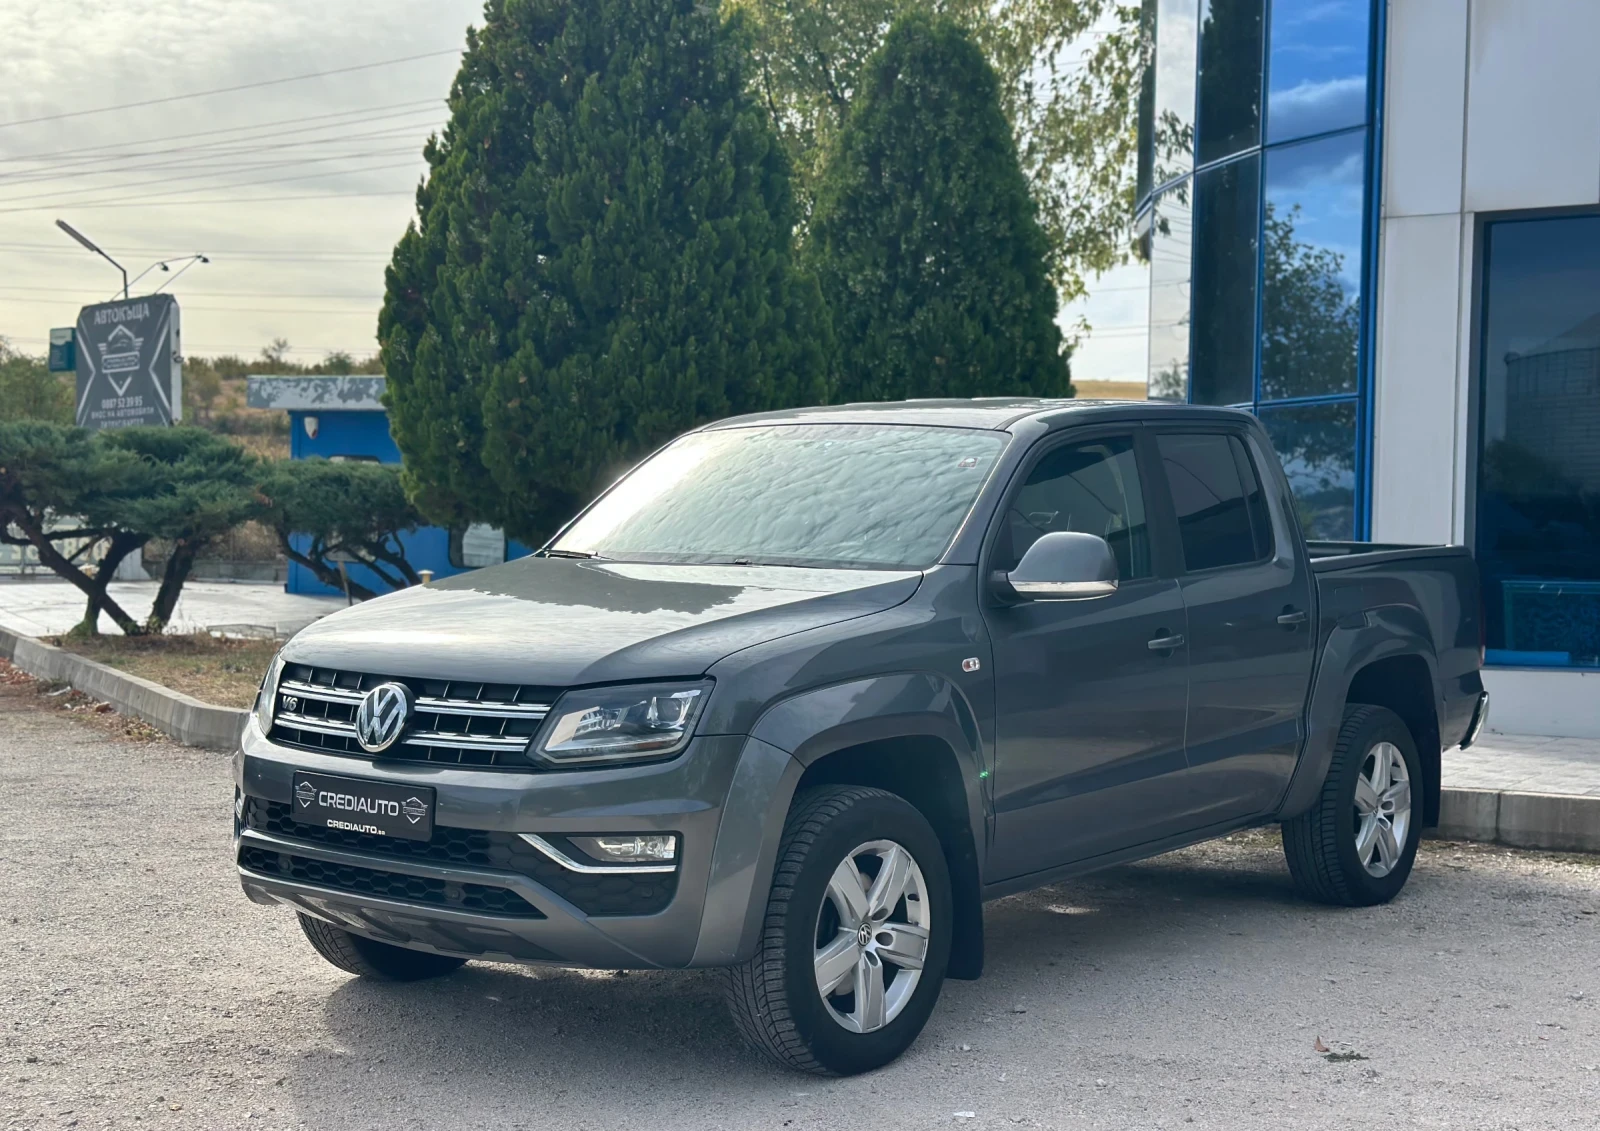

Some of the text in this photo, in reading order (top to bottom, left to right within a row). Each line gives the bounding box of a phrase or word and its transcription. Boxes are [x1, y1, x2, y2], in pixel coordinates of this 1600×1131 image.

[94, 302, 149, 326] АВТОКЪЩА
[282, 695, 299, 711] V6
[318, 791, 399, 816] CREDIAUTO
